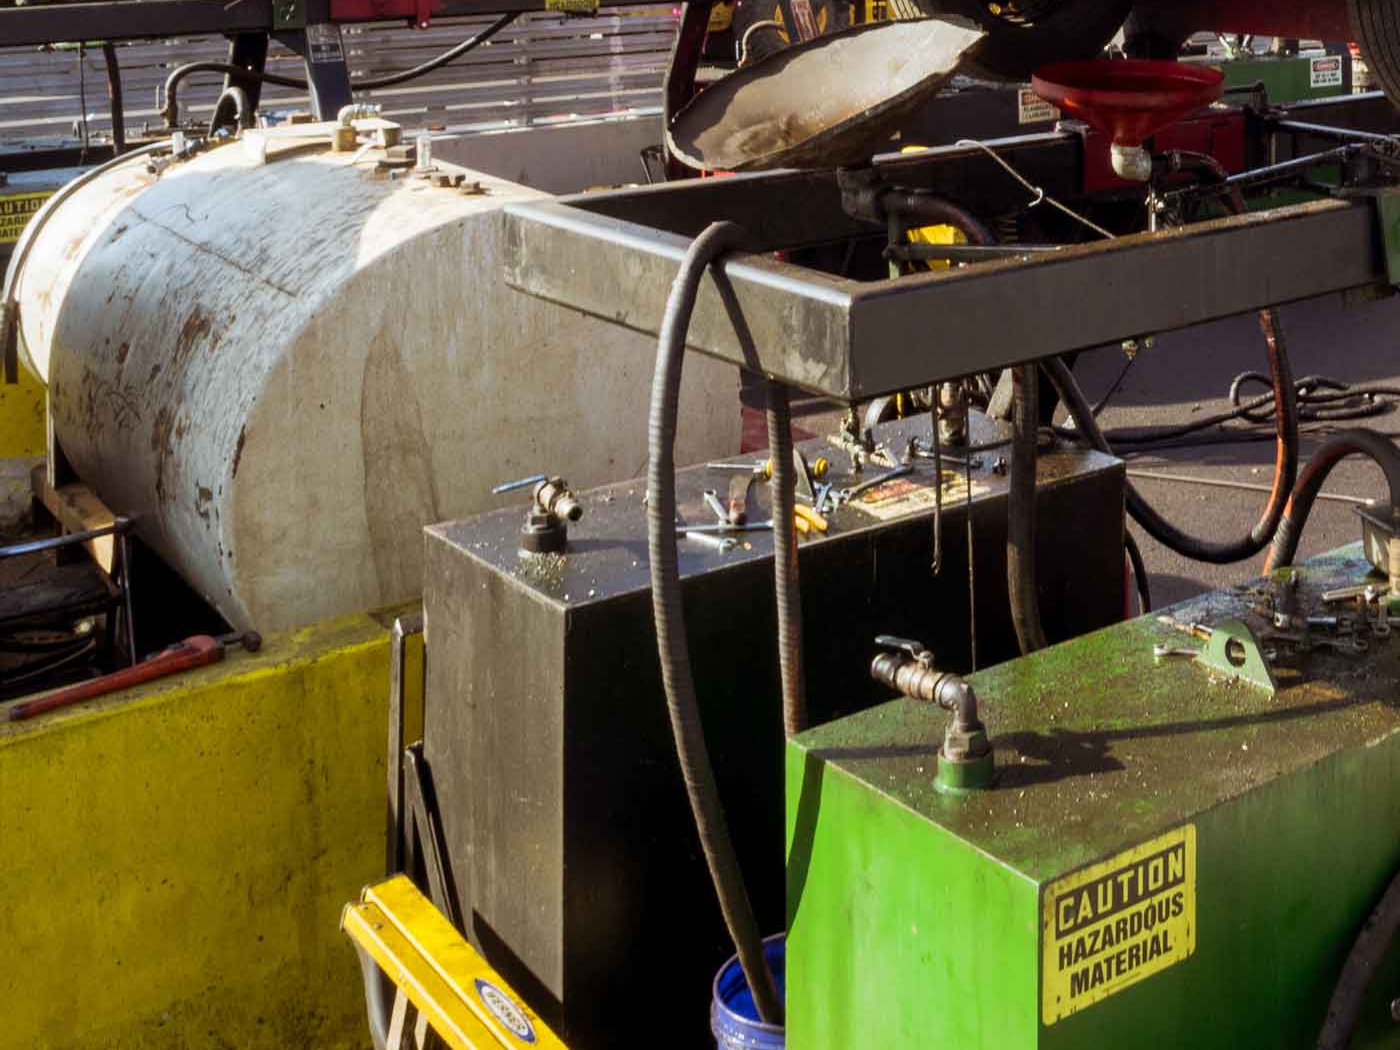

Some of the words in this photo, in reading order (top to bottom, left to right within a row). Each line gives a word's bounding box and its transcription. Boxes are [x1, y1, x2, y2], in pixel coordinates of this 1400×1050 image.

[1057, 846, 1184, 933] CAUTION
[1058, 891, 1185, 971] HAZARDOUS
[1070, 928, 1173, 999] MATERIAL
